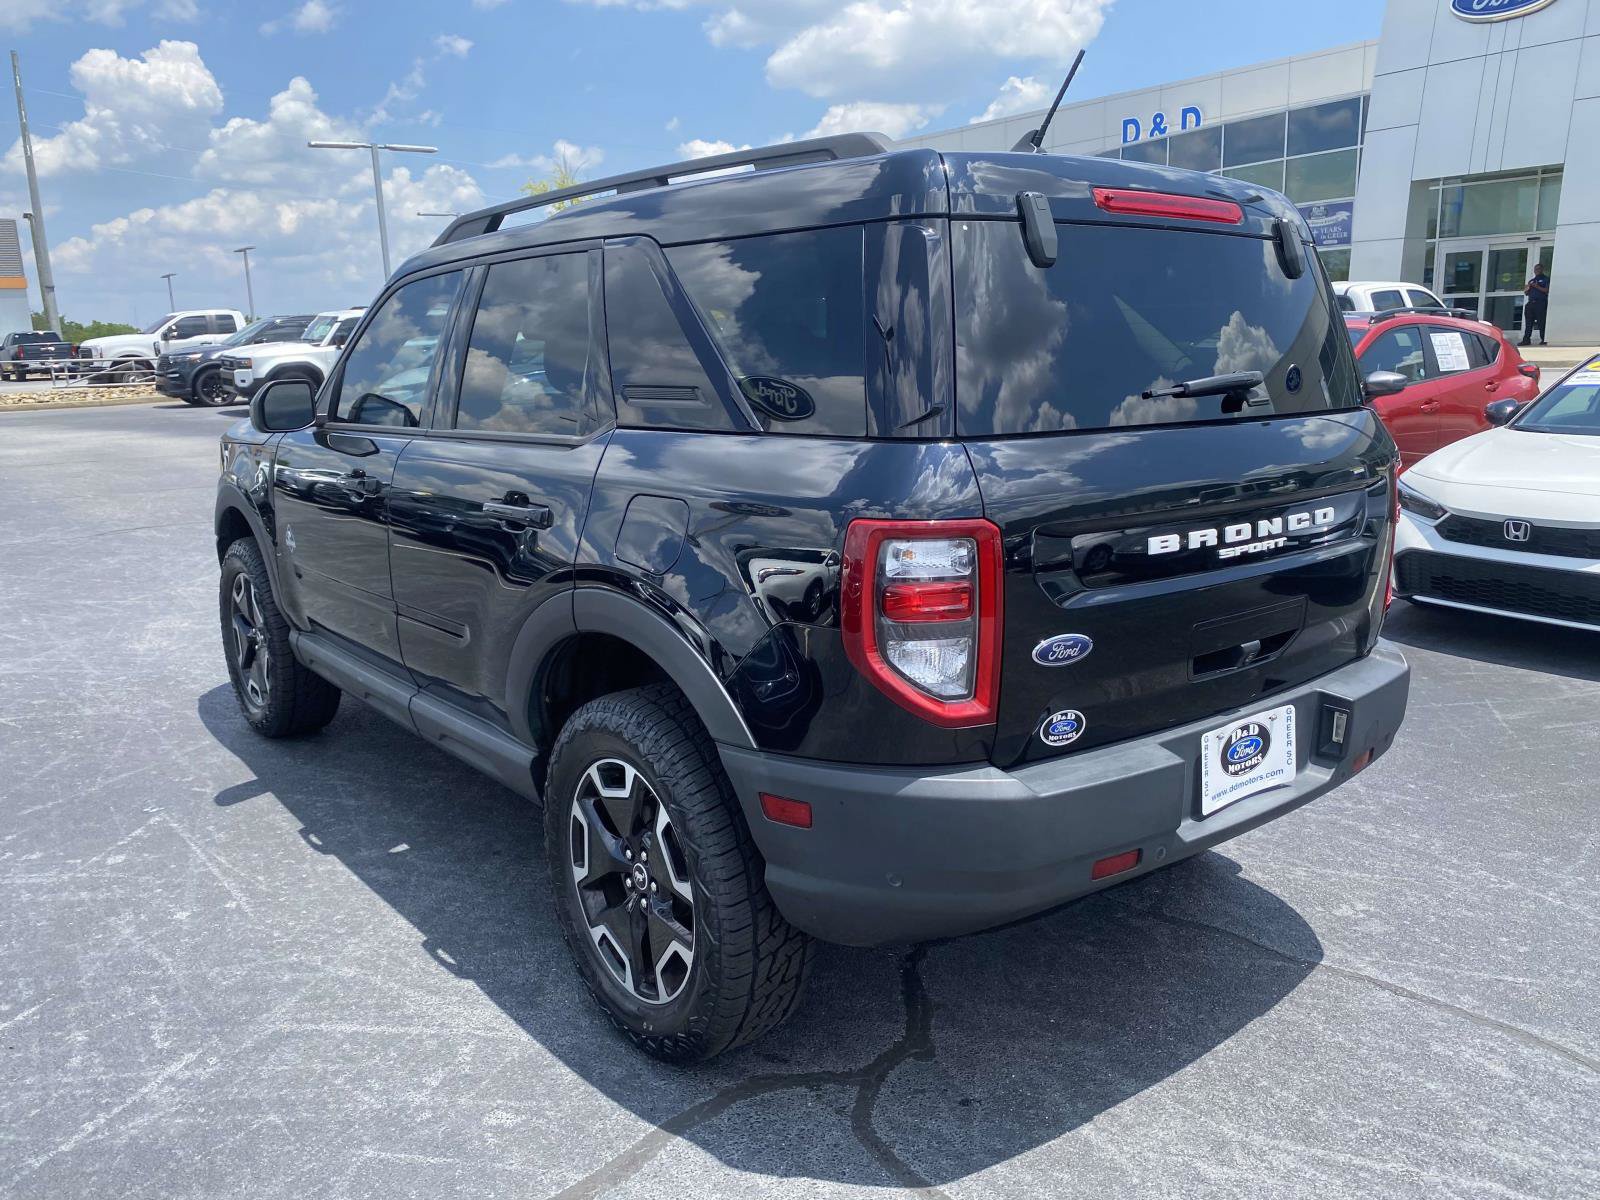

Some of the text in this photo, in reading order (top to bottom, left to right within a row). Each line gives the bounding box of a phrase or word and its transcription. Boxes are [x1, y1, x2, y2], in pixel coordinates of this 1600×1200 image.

[1121, 106, 1202, 144] D & D
[1147, 506, 1335, 555] BRONCO
[1218, 537, 1287, 559] SPORT
[1048, 641, 1082, 660] Ford
[1052, 712, 1075, 723] D&D
[1055, 722, 1072, 733] Ford
[1048, 731, 1077, 741] MOTORS
[1231, 723, 1260, 744] D&D
[1234, 740, 1256, 759] Ford
[1228, 753, 1263, 774] MOTORS
[1211, 768, 1284, 801] www.ddmotors.com
